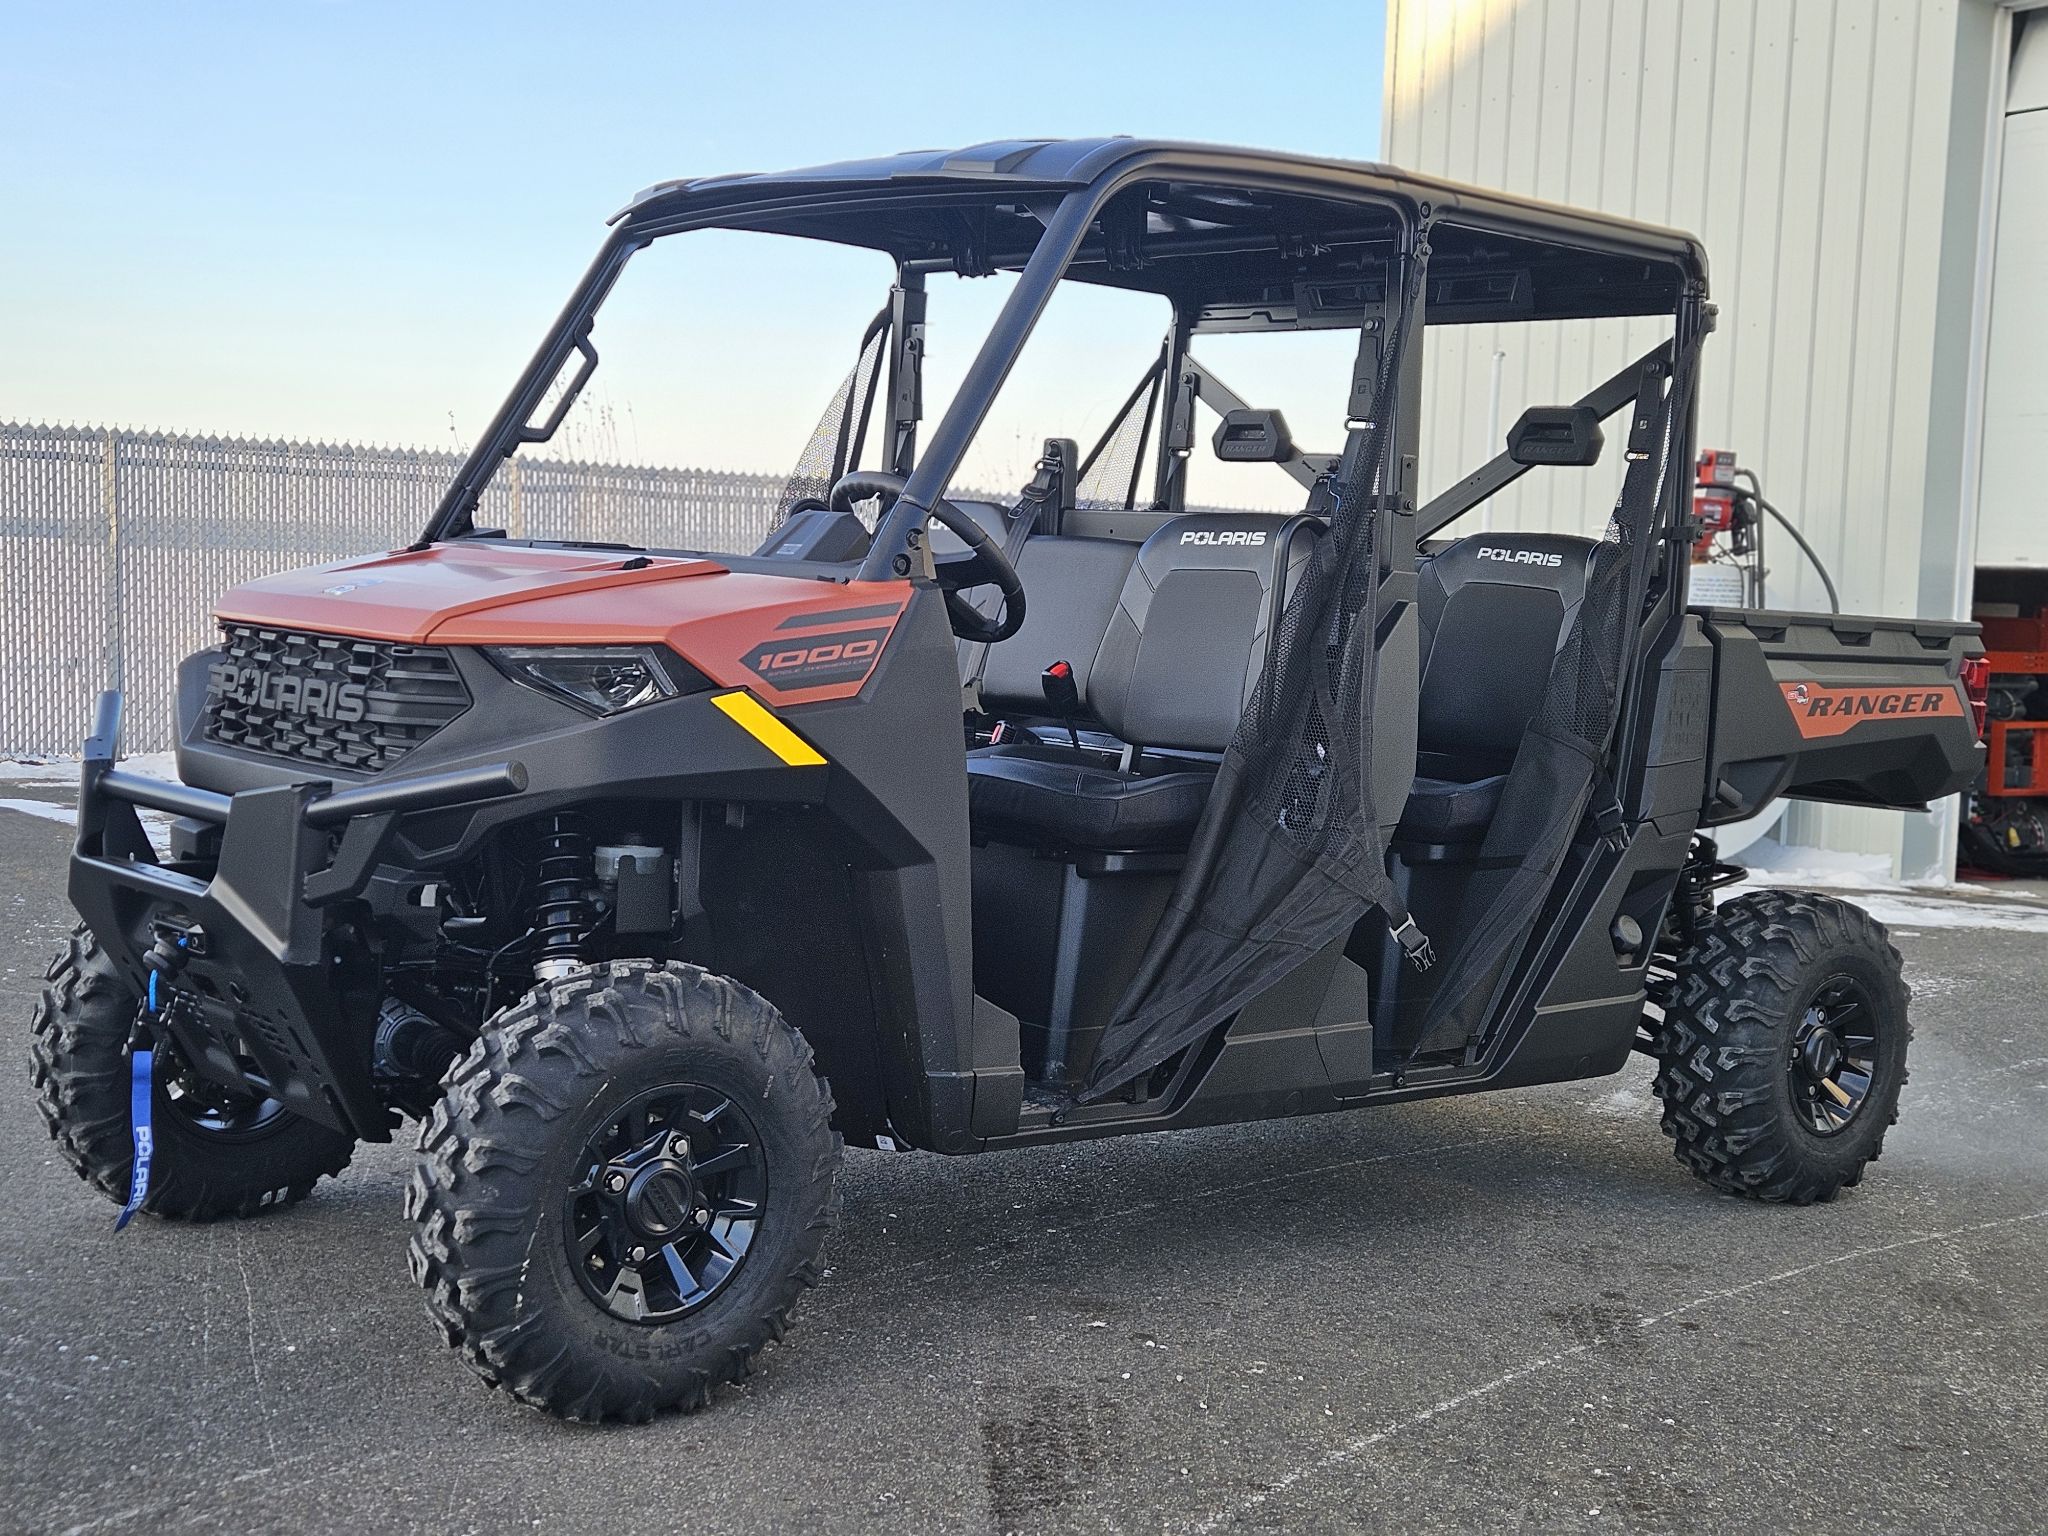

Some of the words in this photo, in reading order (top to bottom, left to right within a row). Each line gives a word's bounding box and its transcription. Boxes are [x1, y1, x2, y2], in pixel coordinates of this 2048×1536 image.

[1180, 531, 1267, 546] POLARIS
[1477, 547, 1563, 567] POLARIS
[758, 640, 878, 671] 1000
[216, 665, 367, 722] POLARIS
[1806, 692, 1944, 717] RANGER
[127, 1126, 152, 1212] POLARIS
